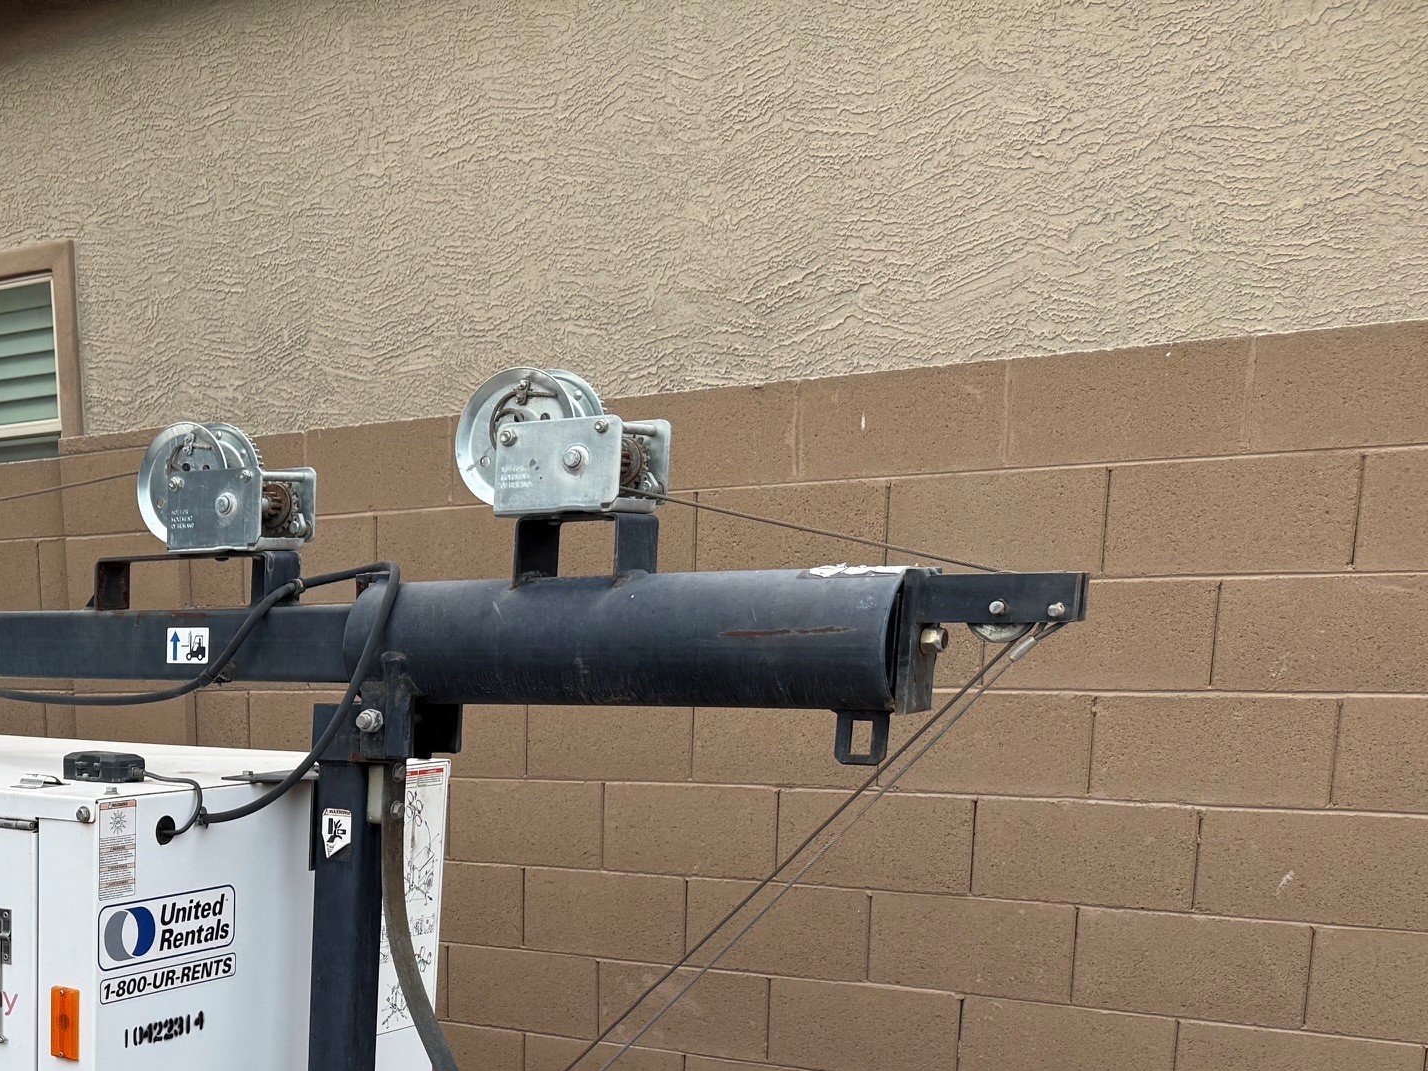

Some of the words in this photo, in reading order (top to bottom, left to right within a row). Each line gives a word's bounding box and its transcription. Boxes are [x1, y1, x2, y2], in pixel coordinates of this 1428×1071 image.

[160, 893, 225, 926] United
[159, 919, 230, 951] Rentals
[103, 956, 233, 1000] 1-800-UR-RENTS
[124, 1010, 205, 1048] 10422314
